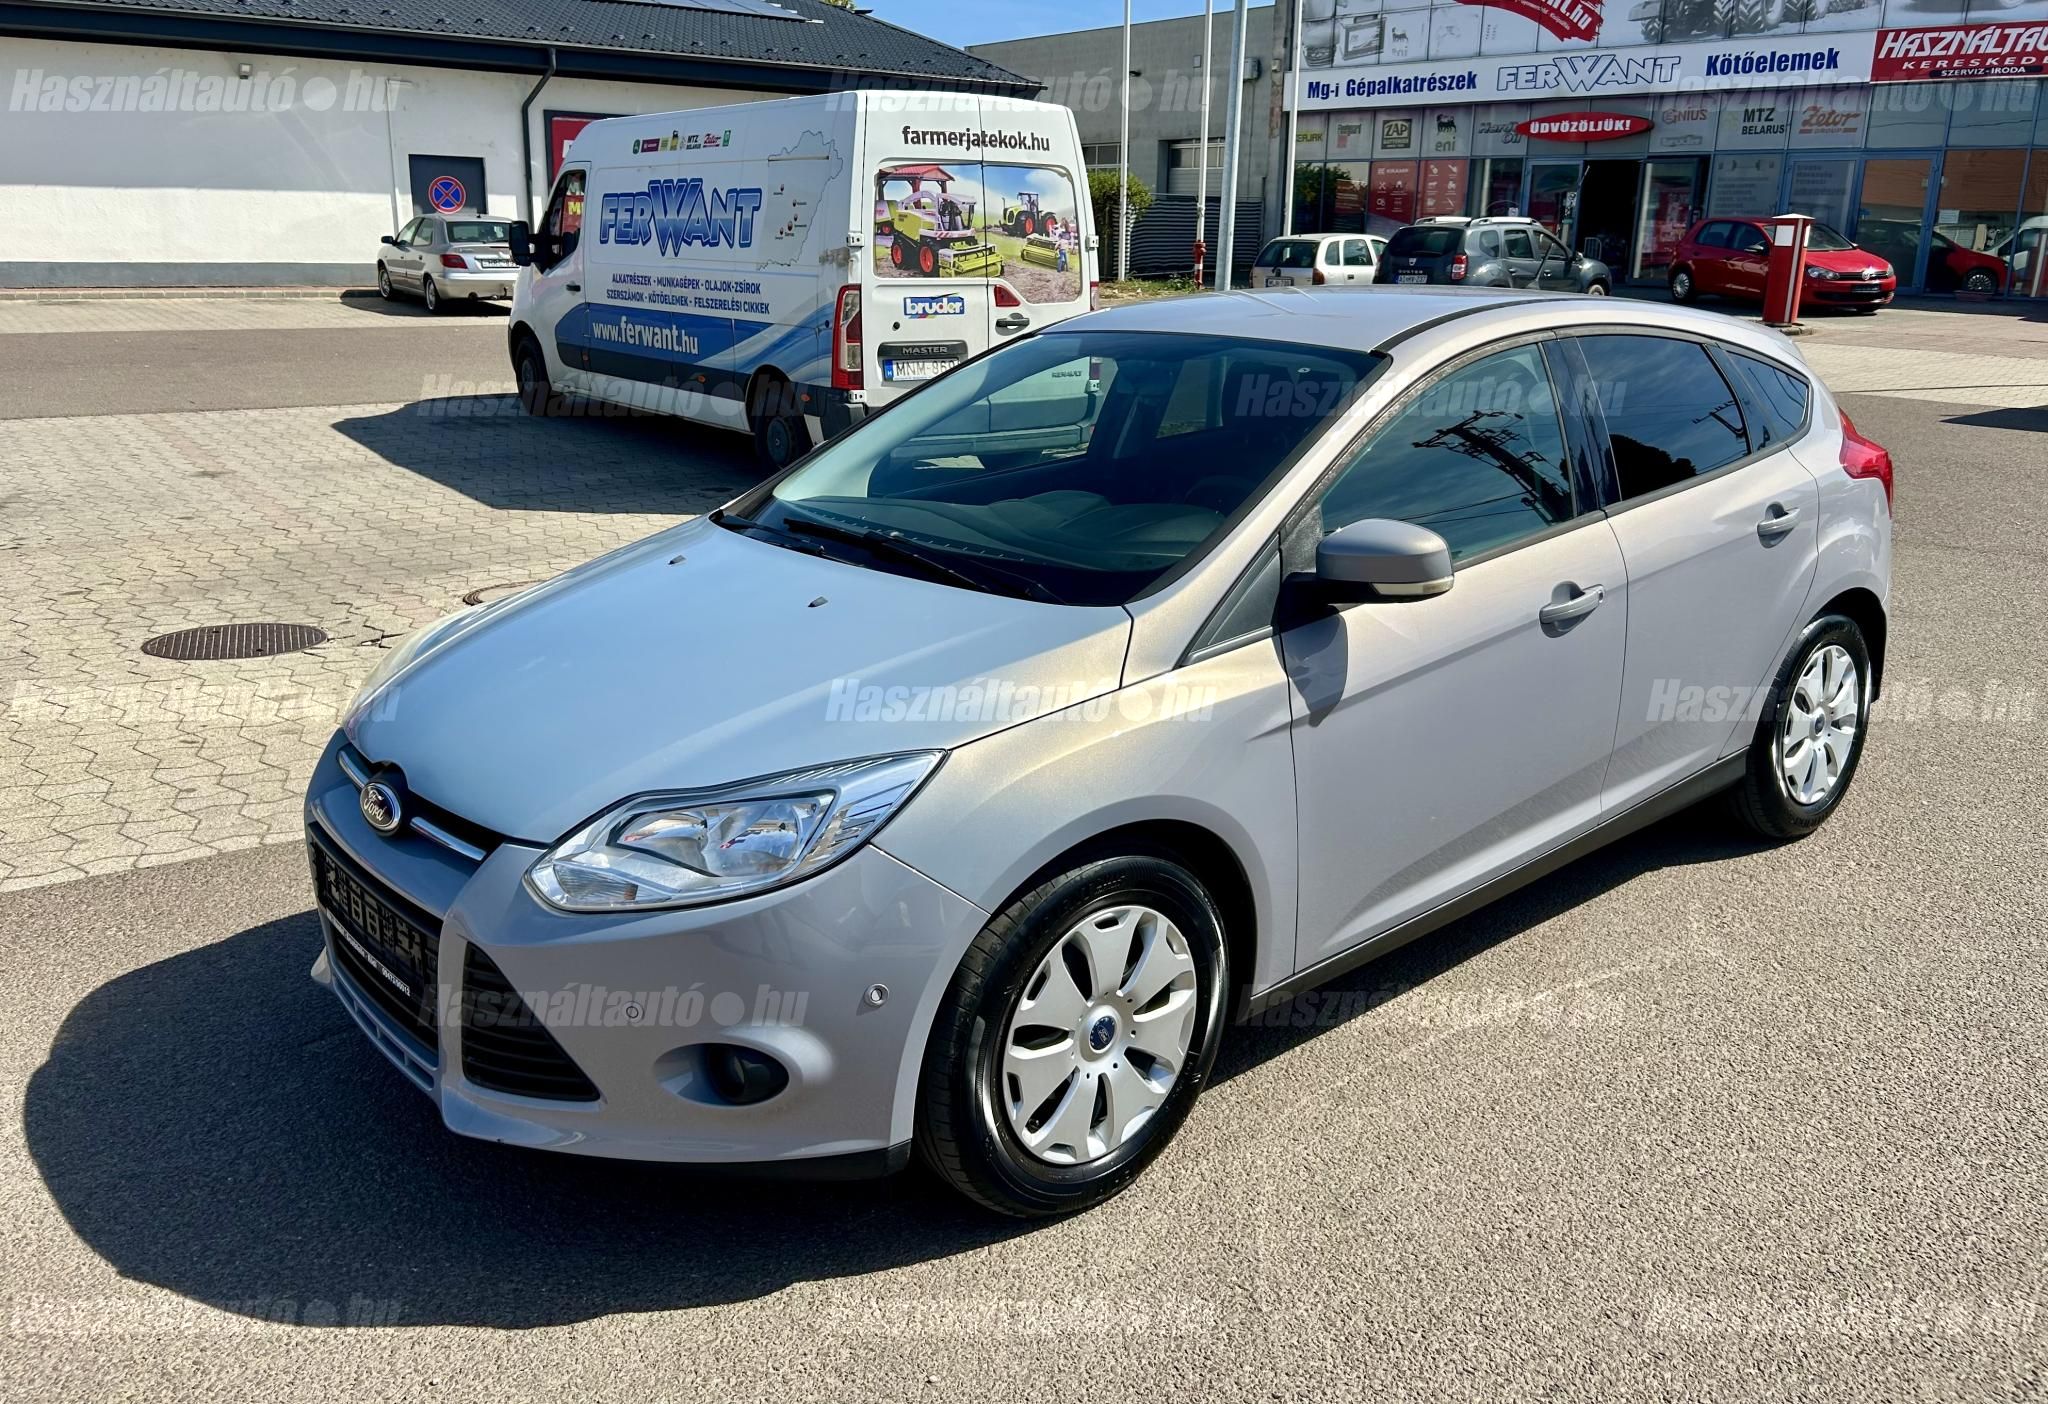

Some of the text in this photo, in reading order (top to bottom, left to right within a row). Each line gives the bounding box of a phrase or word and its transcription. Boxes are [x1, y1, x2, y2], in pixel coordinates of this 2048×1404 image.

[1705, 47, 1841, 77] Kötőelemek
[1307, 71, 1478, 100] Mg-i Gépalkatrészek
[1743, 107, 1776, 123] MTZ
[1385, 122, 1409, 137] ZAP
[1529, 118, 1632, 134] ÜDVÖZÖLJÜK!
[1741, 124, 1786, 136] BELARUS
[902, 125, 1051, 152] farmerjatekok.hu
[1435, 136, 1456, 152] eni
[600, 178, 763, 257] FERWANT
[612, 273, 652, 287] ALKATRÉSZEK
[656, 275, 701, 290] MUNKAGÉPEK
[606, 288, 645, 302] SZERSZÁMOK
[694, 296, 743, 312] FELSZERELÉSI
[743, 301, 770, 315] CIKKEK
[906, 297, 964, 315] bruder
[592, 315, 699, 355] www.ferwant.hu
[902, 346, 948, 355] MASTER
[363, 789, 387, 822] Ford
